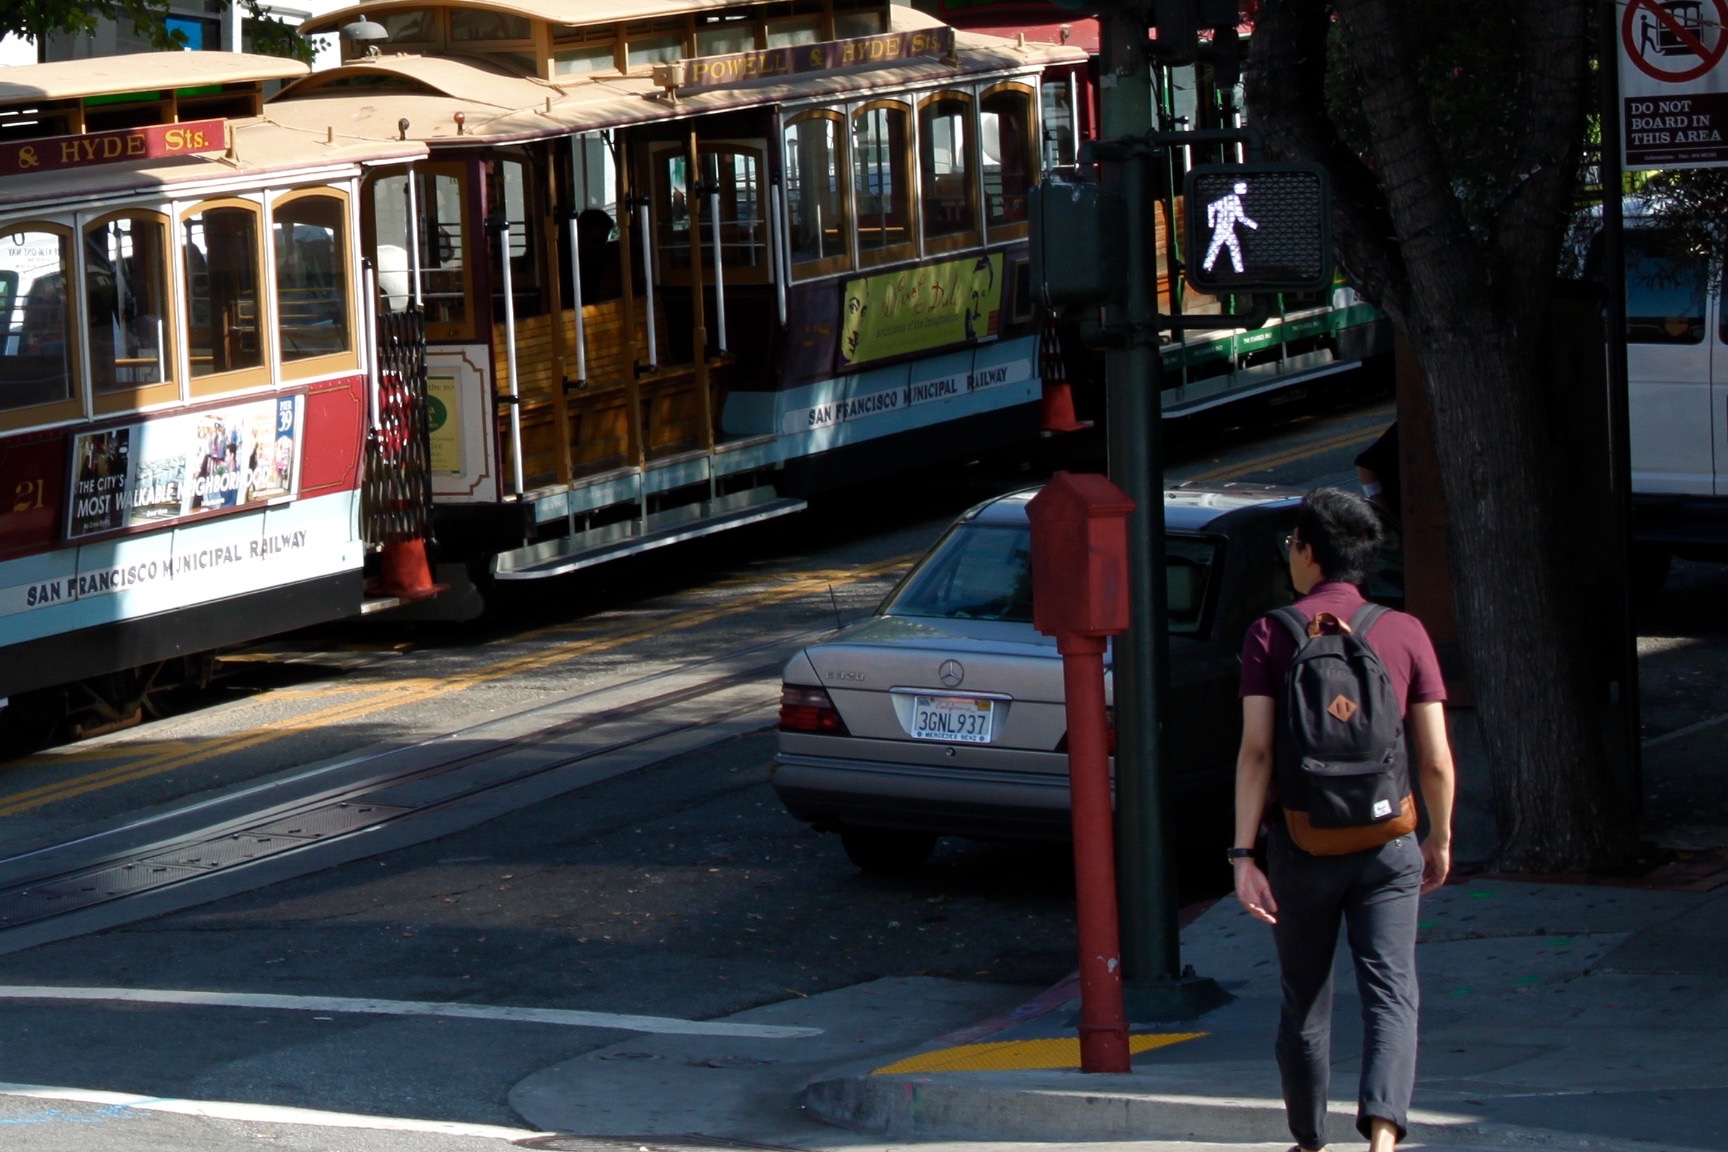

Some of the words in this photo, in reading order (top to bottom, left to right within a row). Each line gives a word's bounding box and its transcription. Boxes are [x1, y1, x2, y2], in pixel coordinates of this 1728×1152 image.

[692, 54, 790, 82] POWELL
[809, 48, 823, 68] &
[841, 37, 901, 64] HYDE
[911, 34, 941, 53] Sts.
[1630, 102, 1654, 115] DO
[1658, 100, 1692, 114] NOT
[1631, 116, 1689, 130] BOARD
[1691, 114, 1711, 127] IN
[17, 146, 40, 169] &
[59, 134, 147, 164] HYDE
[164, 128, 210, 152] Sts.
[1631, 132, 1671, 145] THIS
[1674, 129, 1723, 144] AREA
[279, 399, 293, 412] PIER
[808, 405, 832, 426] SAN
[836, 390, 898, 421] FRANCISCO
[903, 378, 958, 406] MUNICIPAL
[967, 367, 1009, 392] RAILWAY
[279, 410, 293, 432] 39
[12, 479, 44, 513] 21
[79, 479, 95, 495] THE
[97, 474, 125, 493] CITY'S
[77, 494, 112, 519] MOST
[115, 482, 175, 512] WALKABLE
[26, 580, 62, 607] SAN
[67, 560, 159, 600] FRANCISCO
[162, 545, 244, 578] MUNICIPAL
[249, 529, 308, 558] RAILWAY
[919, 711, 987, 736] 3GNL937
